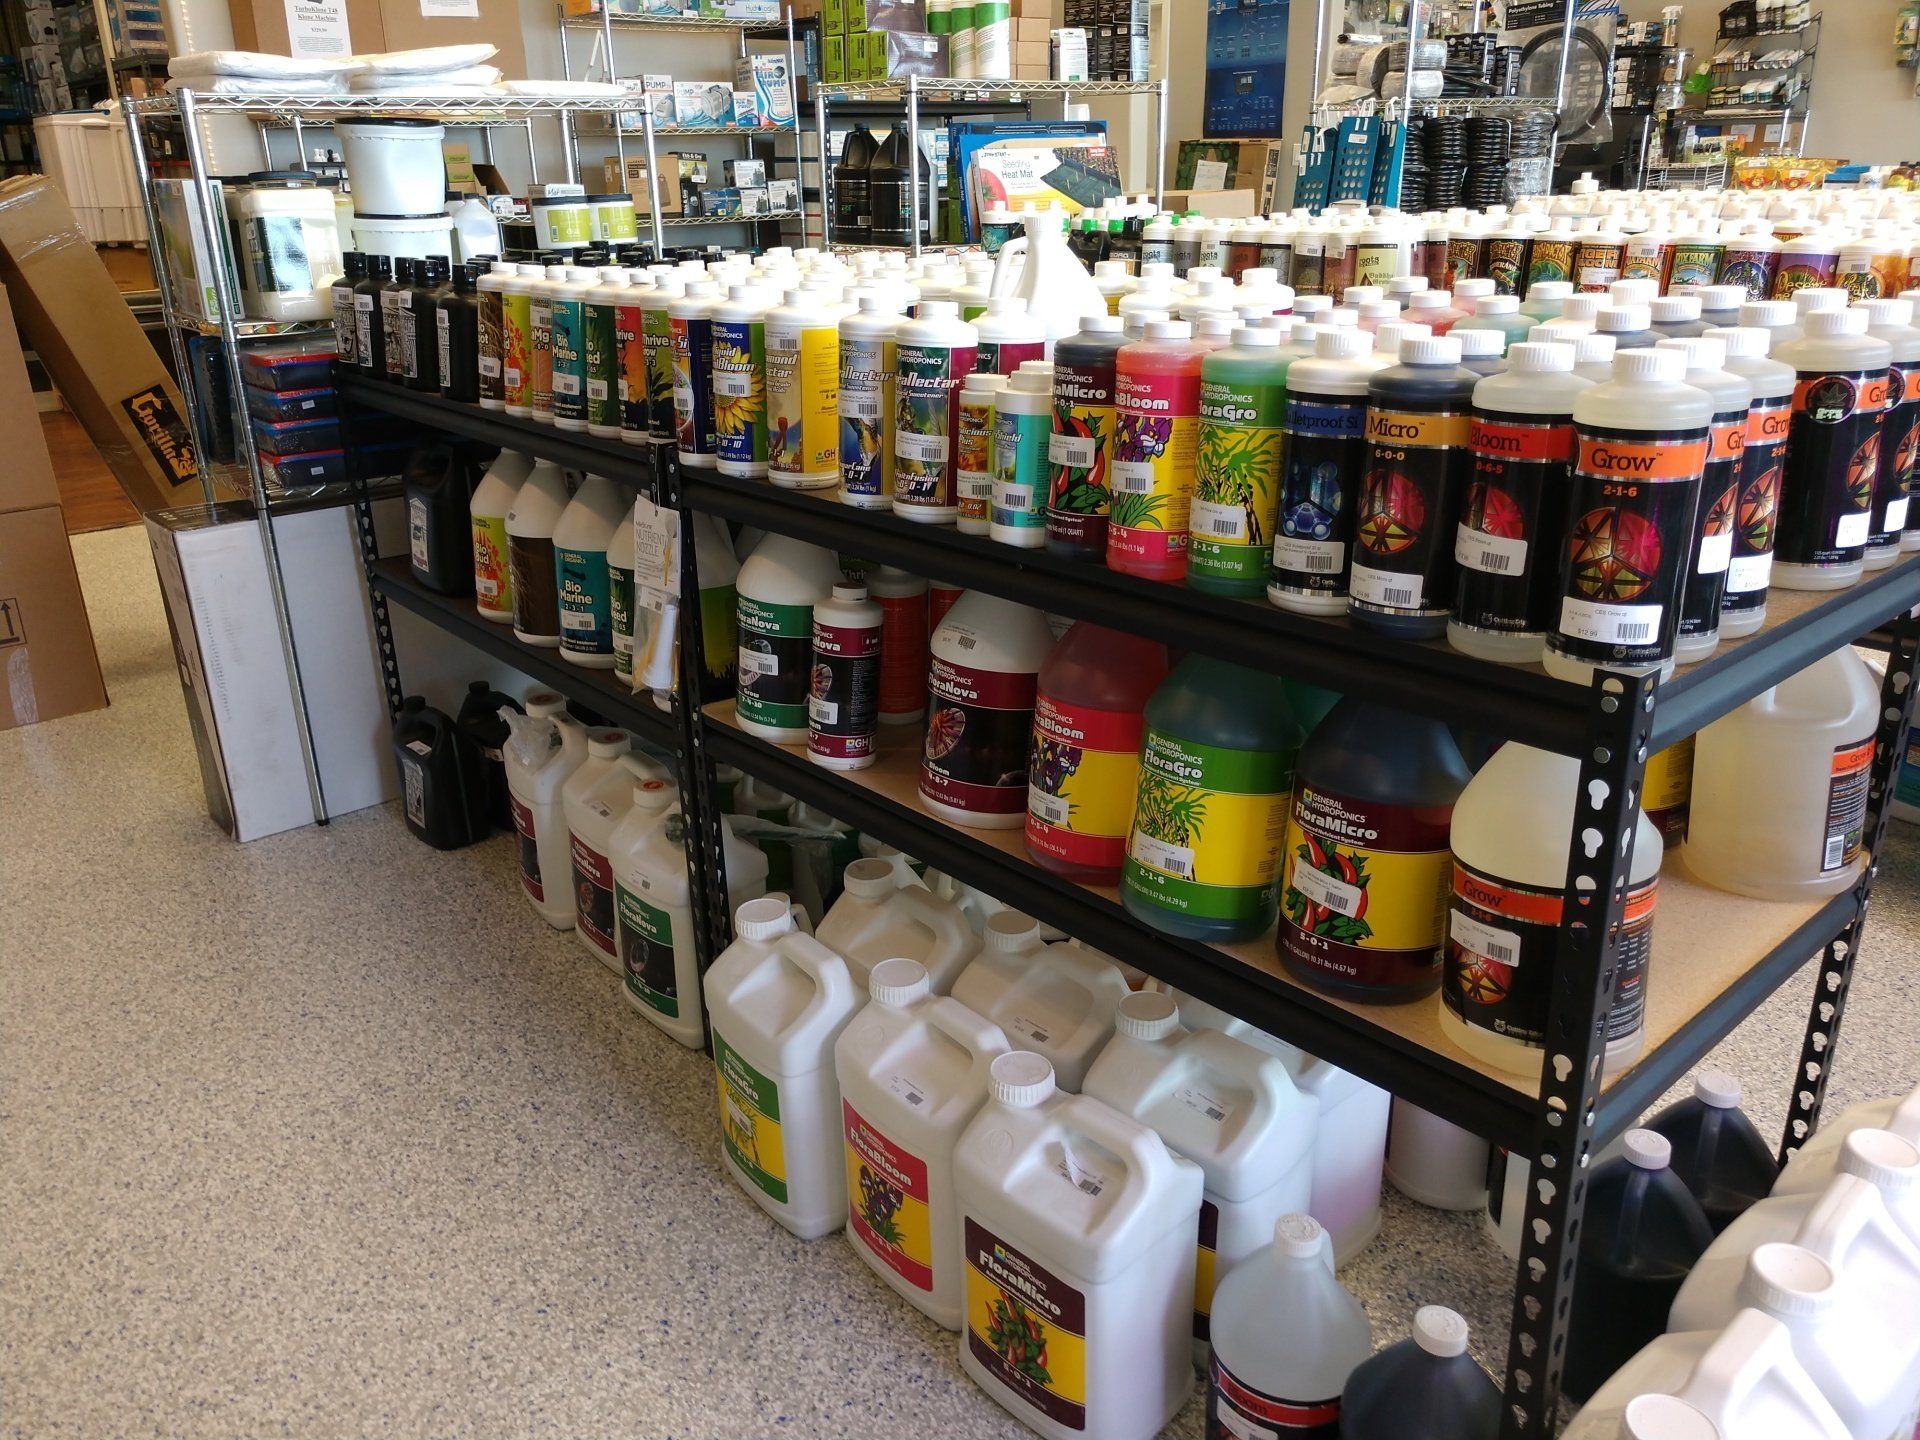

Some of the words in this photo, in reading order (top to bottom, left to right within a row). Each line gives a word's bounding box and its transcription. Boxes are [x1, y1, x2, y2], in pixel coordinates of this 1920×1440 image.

[761, 79, 786, 88] PUMP
[676, 88, 694, 96] PUMP
[1002, 160, 1031, 169] Seedling
[1002, 170, 1018, 179] Heat
[1020, 170, 1033, 178] Mat
[1359, 256, 1379, 264] roots
[1581, 249, 1619, 259] IGER
[1579, 260, 1617, 268] LOOM
[556, 333, 568, 348] Bio
[552, 346, 577, 361] Marine
[901, 350, 923, 358] GENERAL
[766, 367, 792, 378] ectar
[1117, 374, 1132, 383] ENERAL
[1053, 384, 1107, 399] raMicro
[1206, 384, 1230, 394] GENERAL
[1869, 386, 1886, 402] Gro
[1115, 397, 1170, 410] aBloom
[1204, 391, 1252, 403] HYDROPONICS
[1200, 403, 1257, 420] loraGro
[1346, 416, 1358, 428] Si
[1369, 416, 1419, 439] Micro
[1762, 416, 1790, 434] Gro
[1470, 427, 1520, 452] Bloom
[1727, 431, 1744, 450] Gr
[824, 450, 836, 458] GH
[1591, 448, 1656, 473] Grow
[1603, 484, 1638, 497] 2-1-6
[636, 528, 665, 546] NUTRIENT
[637, 540, 659, 557] NOZZLE
[1193, 541, 1220, 554] 2-1-6
[565, 580, 582, 592] Bio
[560, 589, 592, 604] Marine
[565, 604, 584, 612] 2-3-1
[737, 611, 780, 631] FloraNova
[1577, 628, 1598, 637] $12.99
[813, 638, 840, 652] aNova
[928, 672, 978, 700] FloraNova
[1034, 715, 1084, 740] oraBloom
[855, 738, 868, 748] GH
[1156, 737, 1182, 751] GENERAL
[1156, 745, 1202, 765] HYDROPONICS
[929, 761, 950, 776] Bloom
[1145, 748, 1202, 779] FloraGro
[928, 773, 948, 787] 4-8-7
[1313, 793, 1343, 810] GENERAL
[1312, 800, 1366, 823] HYDROPONICS
[1296, 801, 1378, 840] FloraMicro
[1318, 827, 1339, 840] Nutrient
[1340, 834, 1365, 846] System
[1140, 867, 1164, 885] 2-1-6
[1463, 880, 1501, 907] Grow
[1166, 896, 1178, 905] (4.29
[1180, 899, 1188, 908] kg)
[620, 902, 657, 934] FloraNova
[1300, 931, 1328, 950] 5-0-1
[1311, 955, 1323, 965] 10.31
[1324, 959, 1332, 968] lbs
[1332, 962, 1346, 972] (4.67
[1347, 966, 1357, 975] kg)
[723, 1060, 759, 1100] FloraGro
[851, 1126, 912, 1186] FloraBloom
[1006, 1251, 1030, 1274] GENERAL
[1005, 1258, 1047, 1290] HYDROPONICS
[979, 1250, 1062, 1317] FloraMicro
[1228, 1384, 1268, 1417] Bloom
